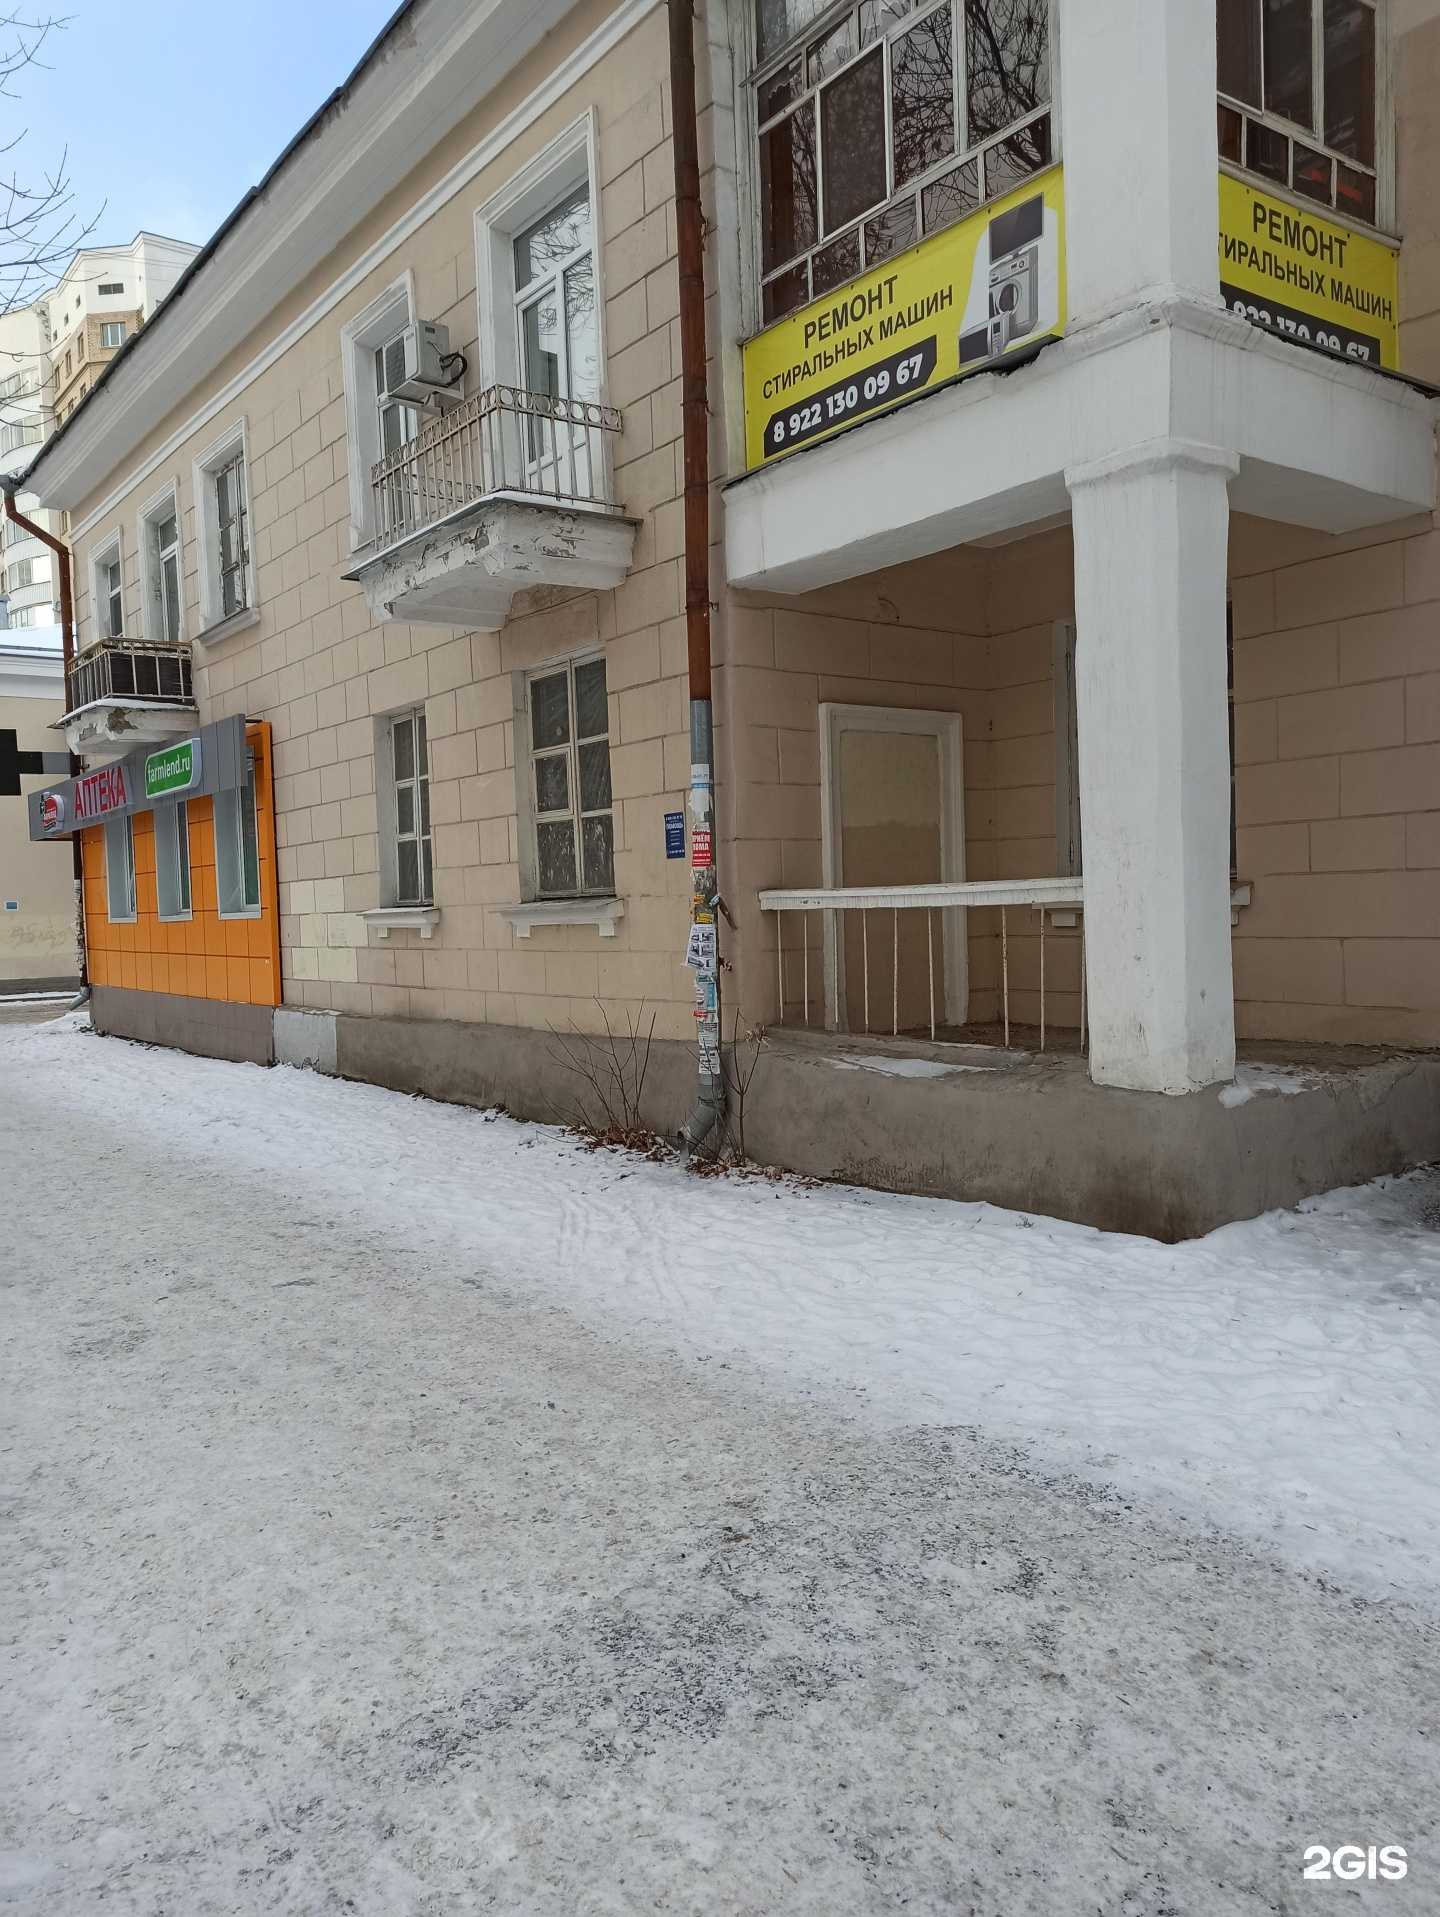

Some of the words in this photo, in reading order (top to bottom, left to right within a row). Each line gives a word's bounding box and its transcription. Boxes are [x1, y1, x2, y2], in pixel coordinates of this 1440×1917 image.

[1253, 202, 1347, 268] РЕМОНТ
[804, 275, 898, 349] РЕМОНТ
[1330, 278, 1392, 321] МАШИН
[763, 326, 874, 399] СТИРАЛЬНЫХ
[879, 284, 953, 341] МАШИН
[773, 420, 785, 443] 8
[789, 403, 822, 436] 922
[826, 385, 858, 418] 130
[864, 370, 890, 399] 09
[896, 352, 923, 384] 67
[75, 767, 127, 819] АПТЕКА
[148, 754, 190, 782] farmlend.ru
